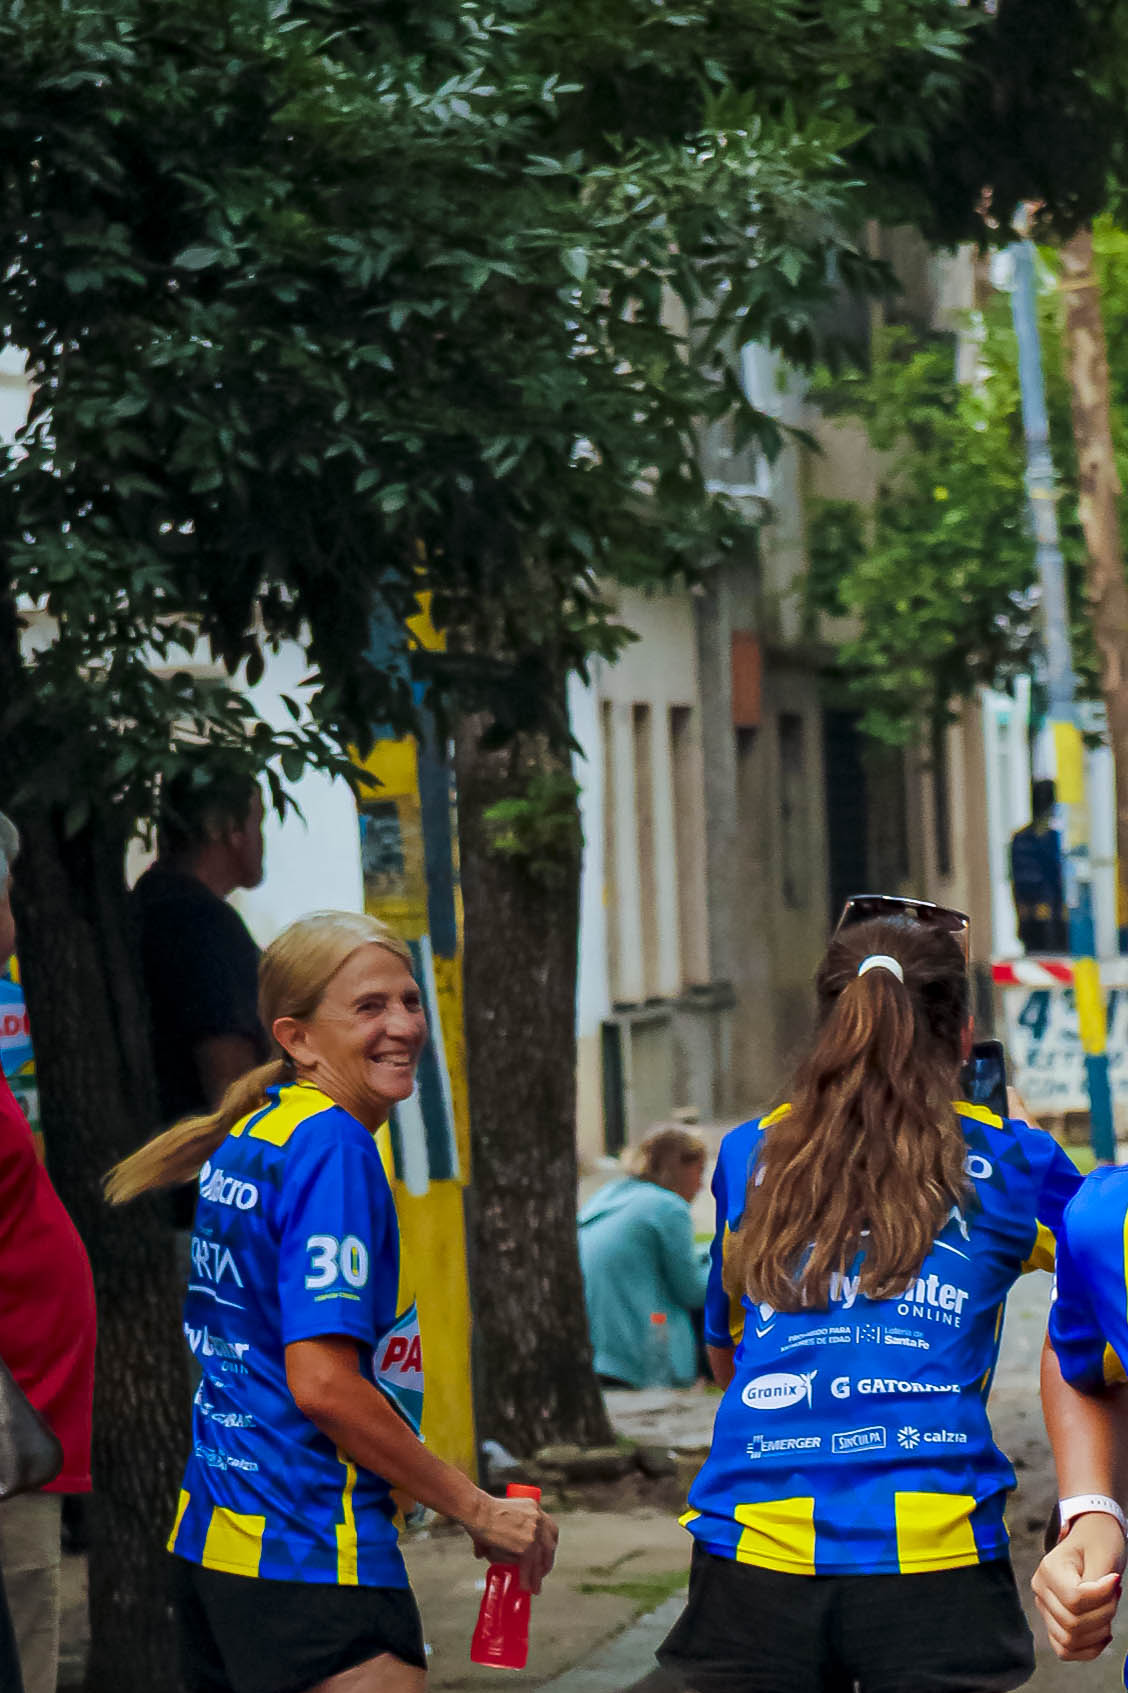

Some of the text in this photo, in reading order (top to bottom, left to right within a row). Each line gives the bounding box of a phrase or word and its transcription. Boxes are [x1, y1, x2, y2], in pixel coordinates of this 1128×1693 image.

[305, 1235, 369, 1289] 30
[897, 1303, 961, 1328] ONLINE
[829, 1326, 851, 1335] PARA
[816, 1337, 827, 1345] DE
[828, 1336, 851, 1344] EDAD
[884, 1335, 930, 1350] Santa Fe
[747, 1383, 797, 1400] Granix
[761, 1437, 821, 1452] EMERGER
